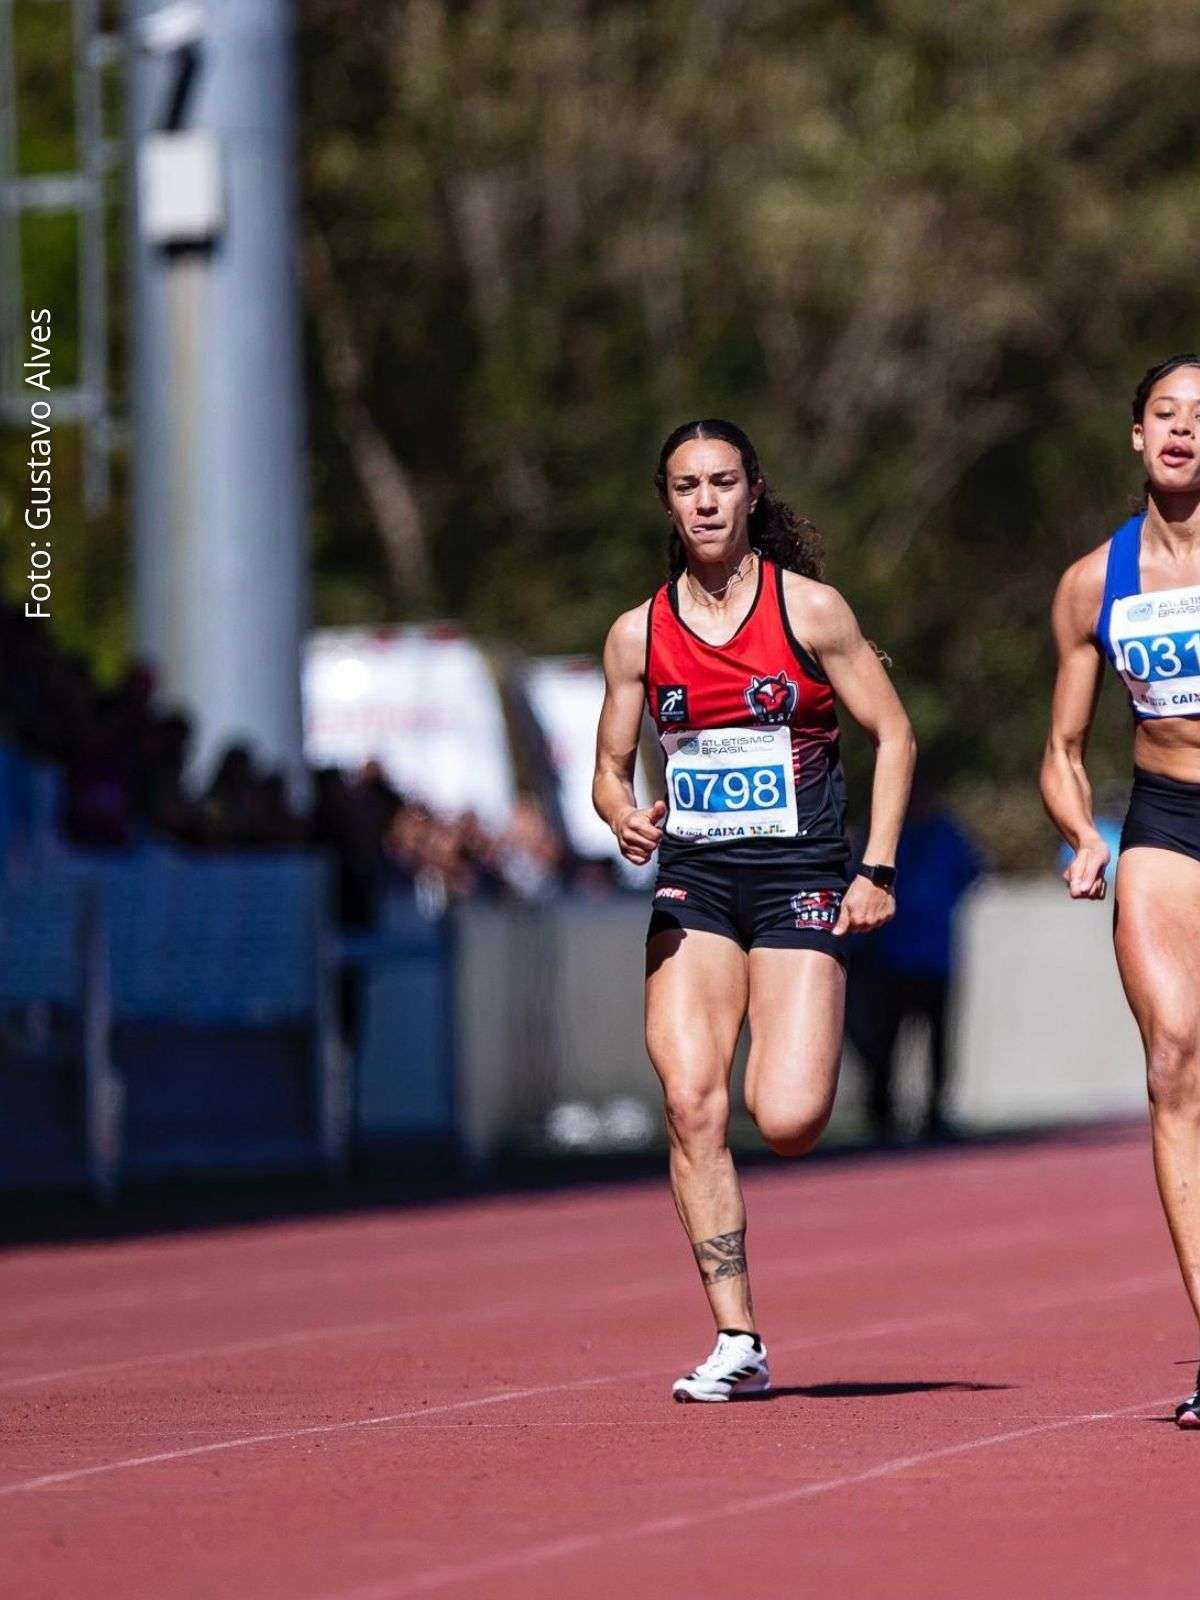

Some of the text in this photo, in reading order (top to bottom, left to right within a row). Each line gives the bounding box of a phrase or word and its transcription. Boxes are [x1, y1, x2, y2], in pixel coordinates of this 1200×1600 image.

[702, 735, 775, 747] ATLETISMO
[701, 746, 748, 755] BRASIL
[674, 769, 780, 810] 0798
[707, 826, 745, 837] CAIXA
